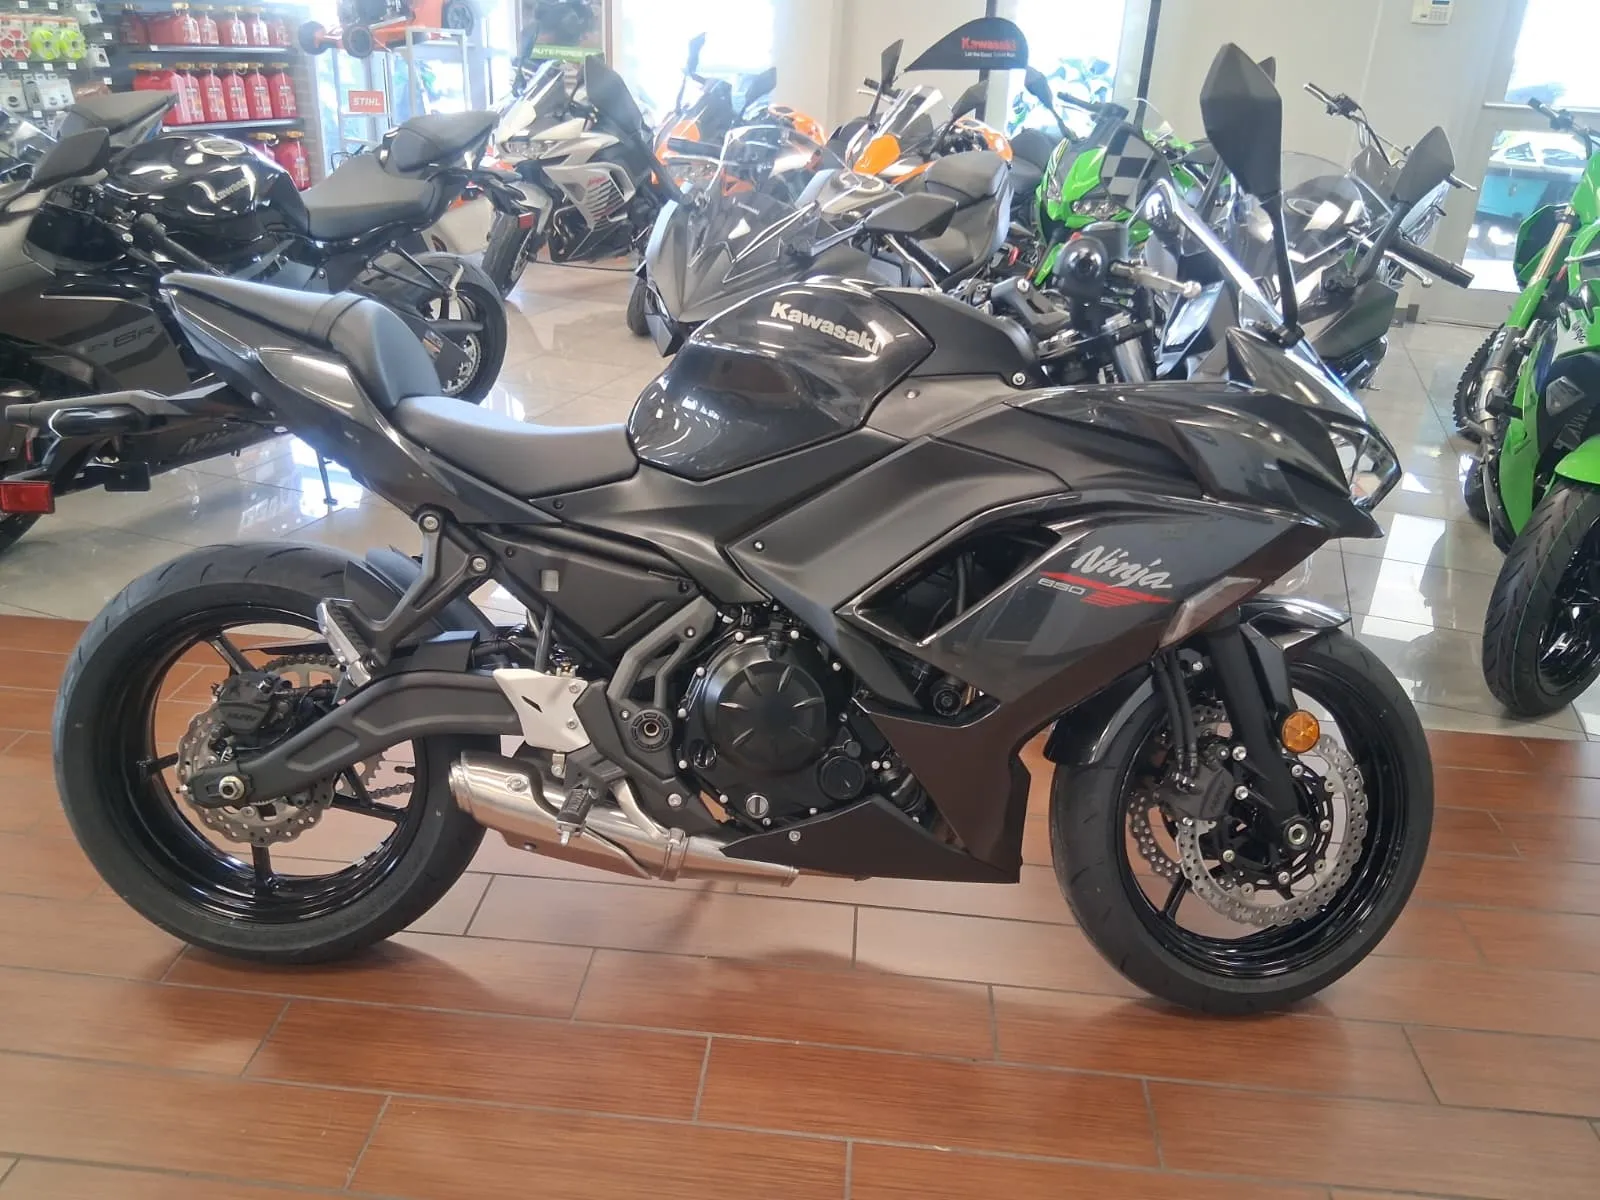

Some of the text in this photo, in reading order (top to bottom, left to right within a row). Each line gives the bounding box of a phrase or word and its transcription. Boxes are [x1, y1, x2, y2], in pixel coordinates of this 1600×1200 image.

[352, 96, 382, 107] STIHL
[770, 301, 881, 355] Kawasaki
[1071, 545, 1173, 589] Ninja
[1037, 577, 1087, 596] 650
